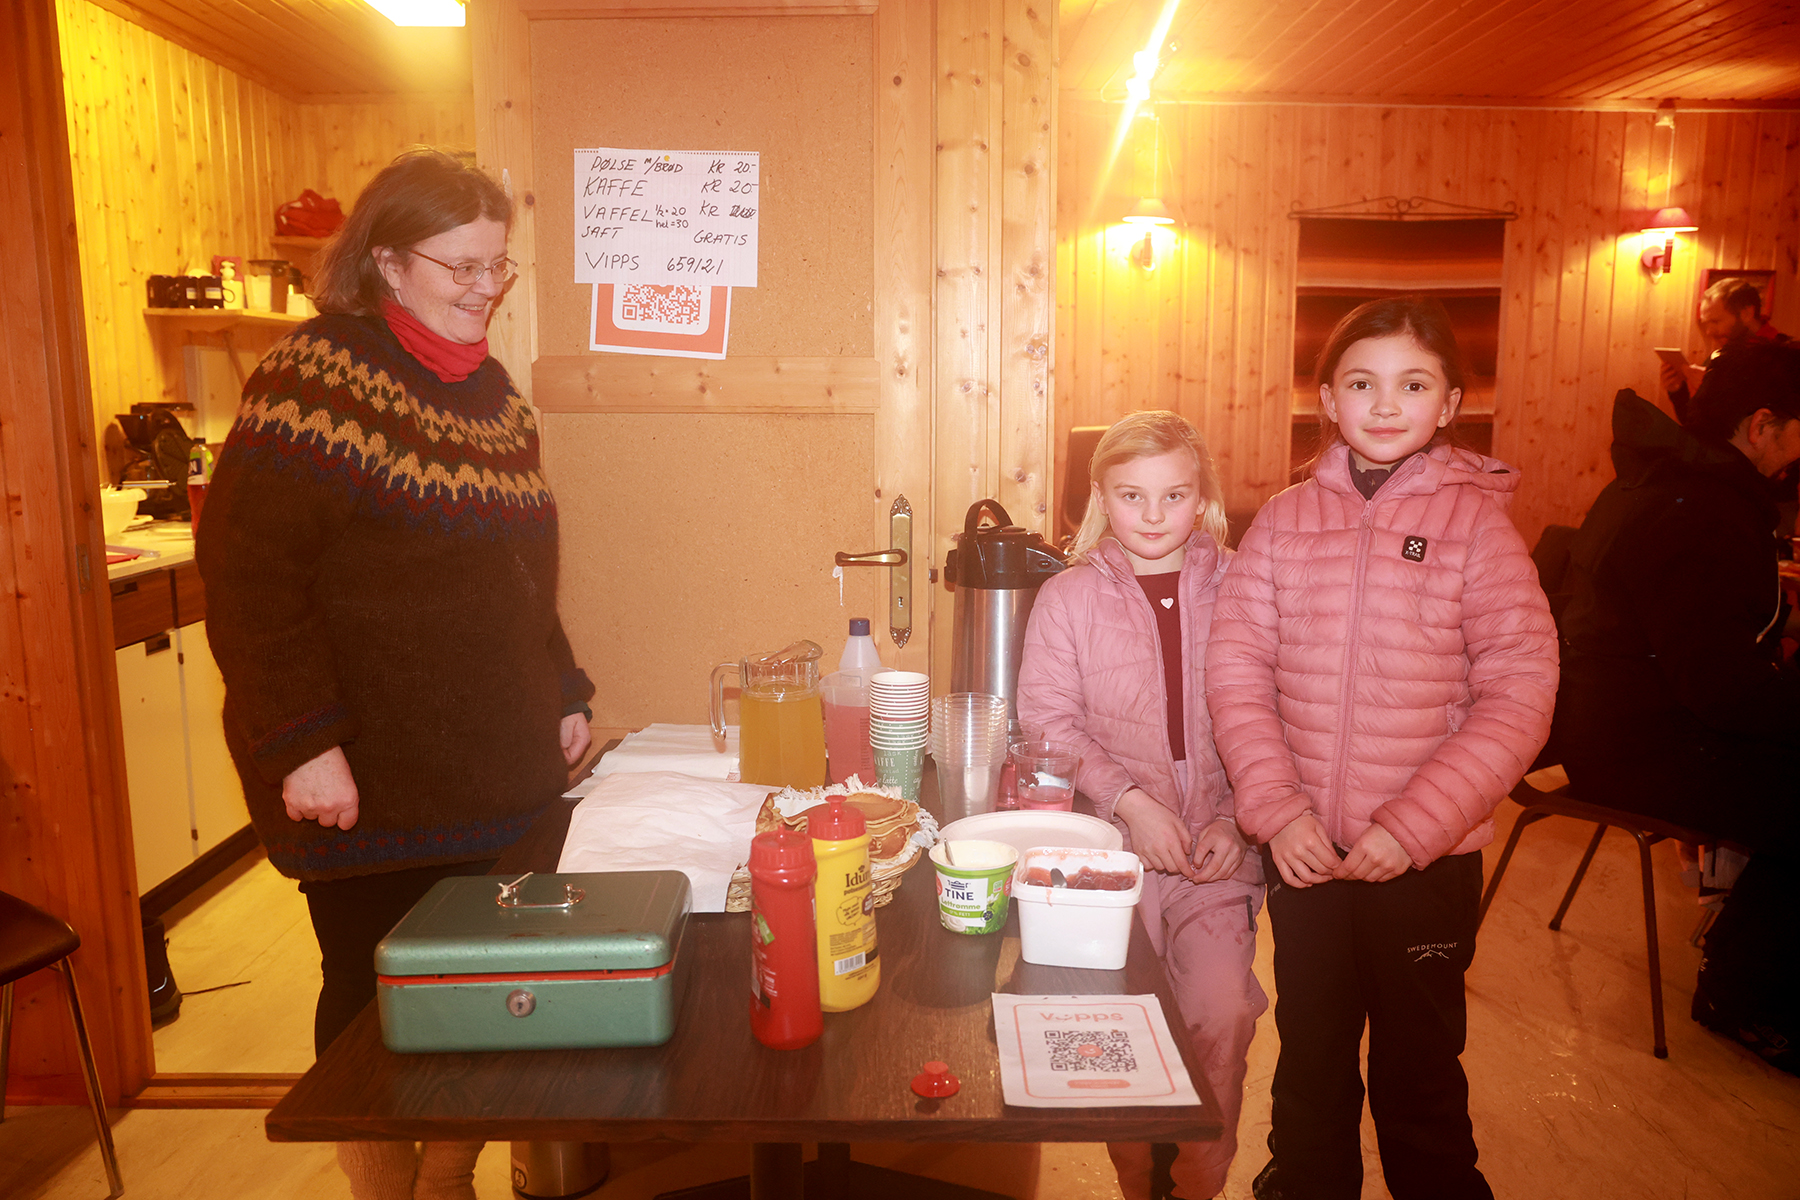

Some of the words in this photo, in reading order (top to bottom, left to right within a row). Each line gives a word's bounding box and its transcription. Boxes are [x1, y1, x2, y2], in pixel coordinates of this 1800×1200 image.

[591, 156, 637, 172] PØLSE
[708, 159, 725, 174] KR
[583, 176, 648, 197] KAFFE
[701, 179, 722, 193] KR
[584, 204, 653, 222] VAFFEL
[699, 200, 720, 217] KR
[581, 226, 624, 239] SAFT
[693, 230, 748, 246] GRATIS
[585, 252, 640, 270] VIPPS
[667, 256, 724, 275] 659121
[945, 888, 974, 901] TINE
[1407, 942, 1458, 953] SWEDEMOUNT
